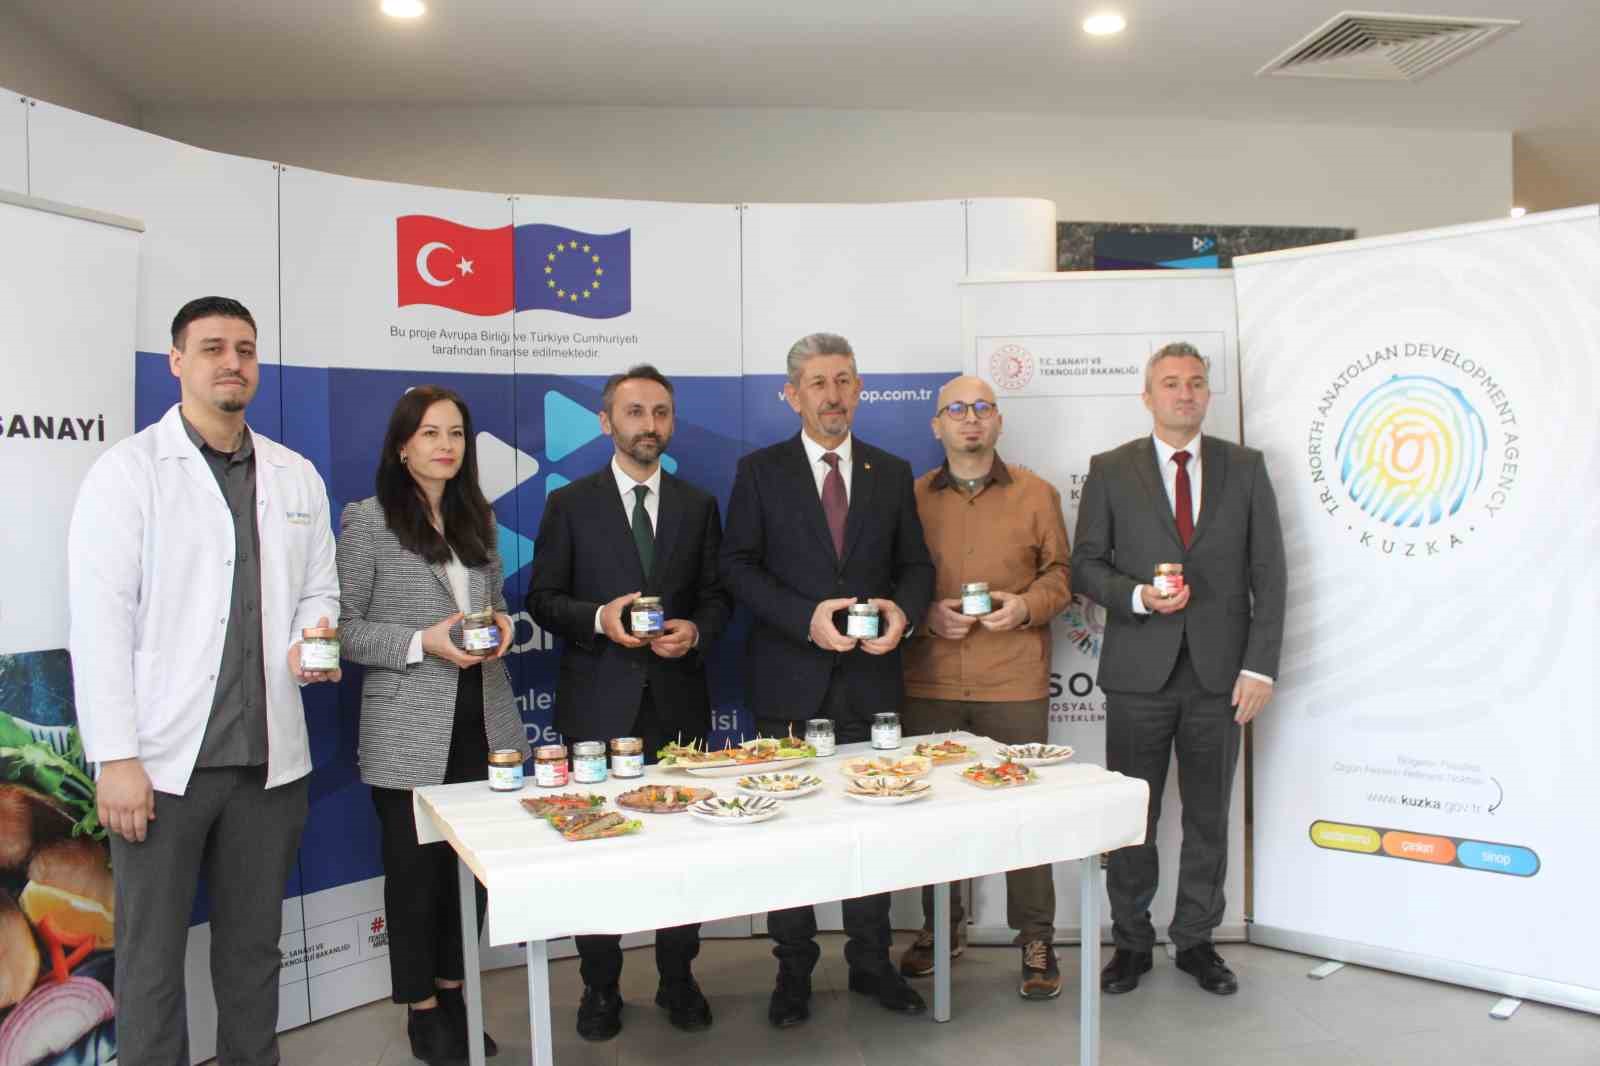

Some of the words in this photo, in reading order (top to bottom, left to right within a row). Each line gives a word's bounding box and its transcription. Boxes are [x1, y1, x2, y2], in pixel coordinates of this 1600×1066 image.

[390, 325, 406, 337] Bu
[409, 327, 436, 342] proje
[439, 328, 478, 342] Avrupa
[529, 331, 570, 346] Türkiye
[572, 332, 639, 347] Cumhuriyeti
[431, 343, 487, 357] tarafından
[489, 346, 529, 358] finanse
[0, 414, 105, 442] ANAYİ
[1308, 420, 1325, 484] NORTH
[1317, 345, 1399, 418] ANATOLIAN
[1404, 343, 1517, 426] DEVELOPMENT
[1484, 432, 1520, 518] AGENCY
[1360, 530, 1464, 557] KUZKA
[1051, 702, 1095, 712] OSYAL
